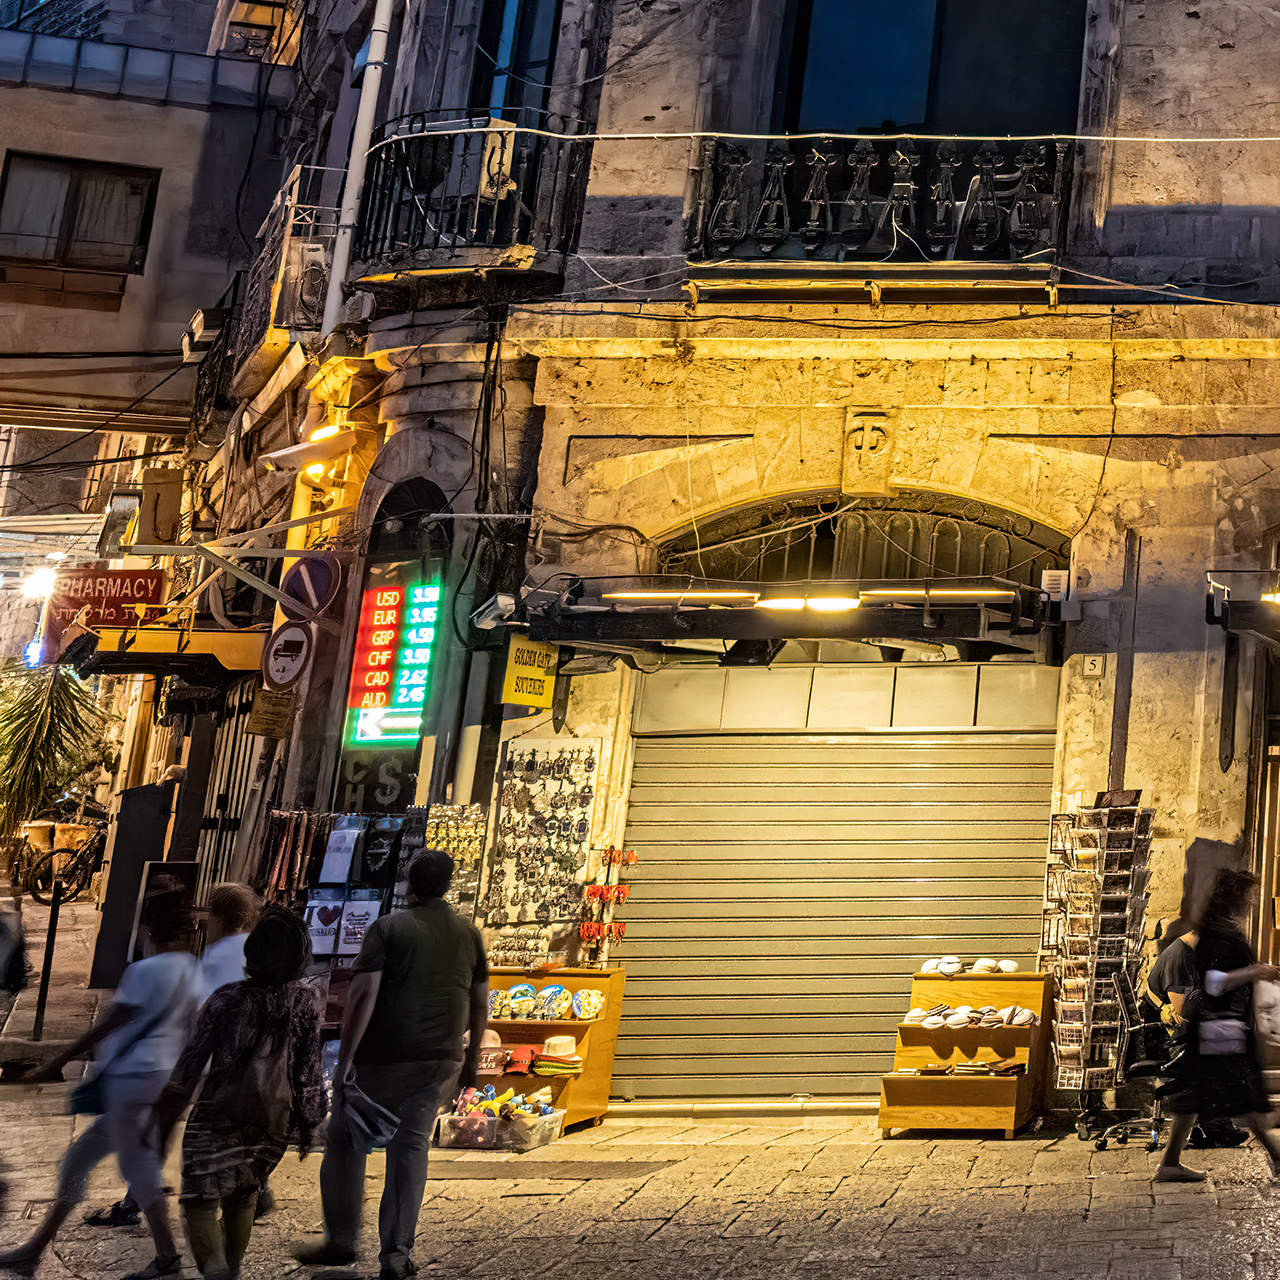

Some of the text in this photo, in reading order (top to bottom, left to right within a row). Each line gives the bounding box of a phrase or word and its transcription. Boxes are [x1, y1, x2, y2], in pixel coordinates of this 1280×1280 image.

[62, 577, 158, 598] PHARMACY
[376, 591, 400, 606] USD
[373, 610, 397, 625] EUR
[372, 630, 395, 646] GBP
[368, 651, 392, 666] CHF
[1088, 659, 1097, 672] 5
[365, 671, 390, 686] CAD
[361, 691, 387, 708] AUD
